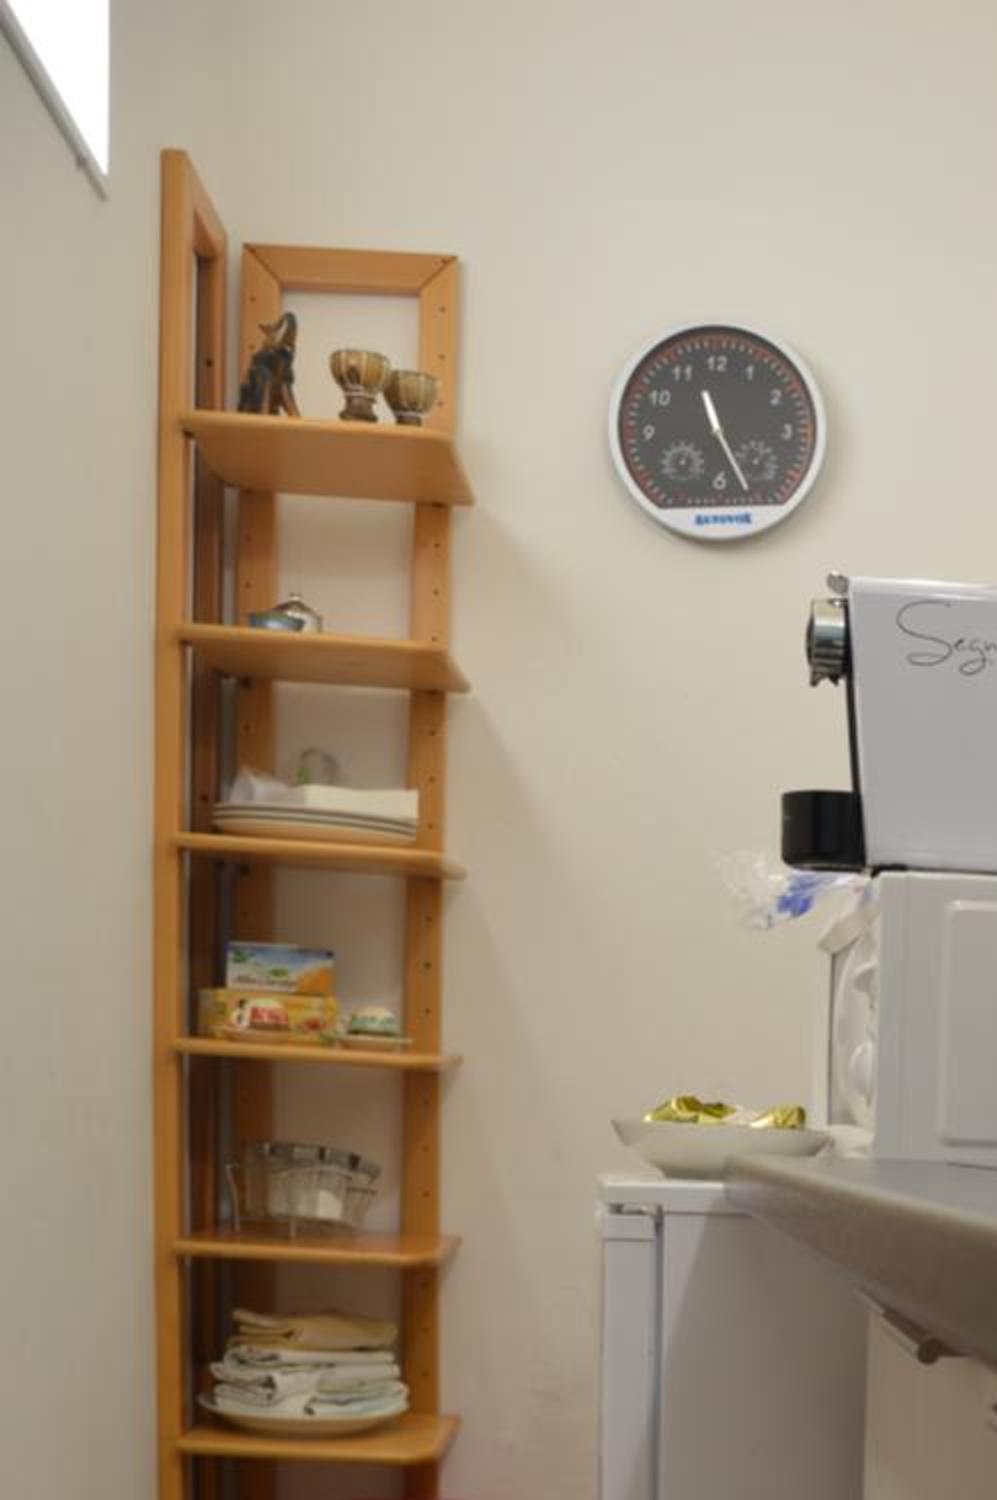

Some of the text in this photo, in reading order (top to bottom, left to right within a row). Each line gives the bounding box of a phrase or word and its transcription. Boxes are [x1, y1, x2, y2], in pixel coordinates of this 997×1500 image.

[706, 356, 728, 372] 12
[672, 366, 693, 381] 11
[744, 365, 754, 381] 1
[650, 390, 671, 406] 10
[770, 389, 782, 406] 2
[643, 425, 655, 441] 9
[781, 424, 793, 441] 3
[713, 472, 727, 490] 6
